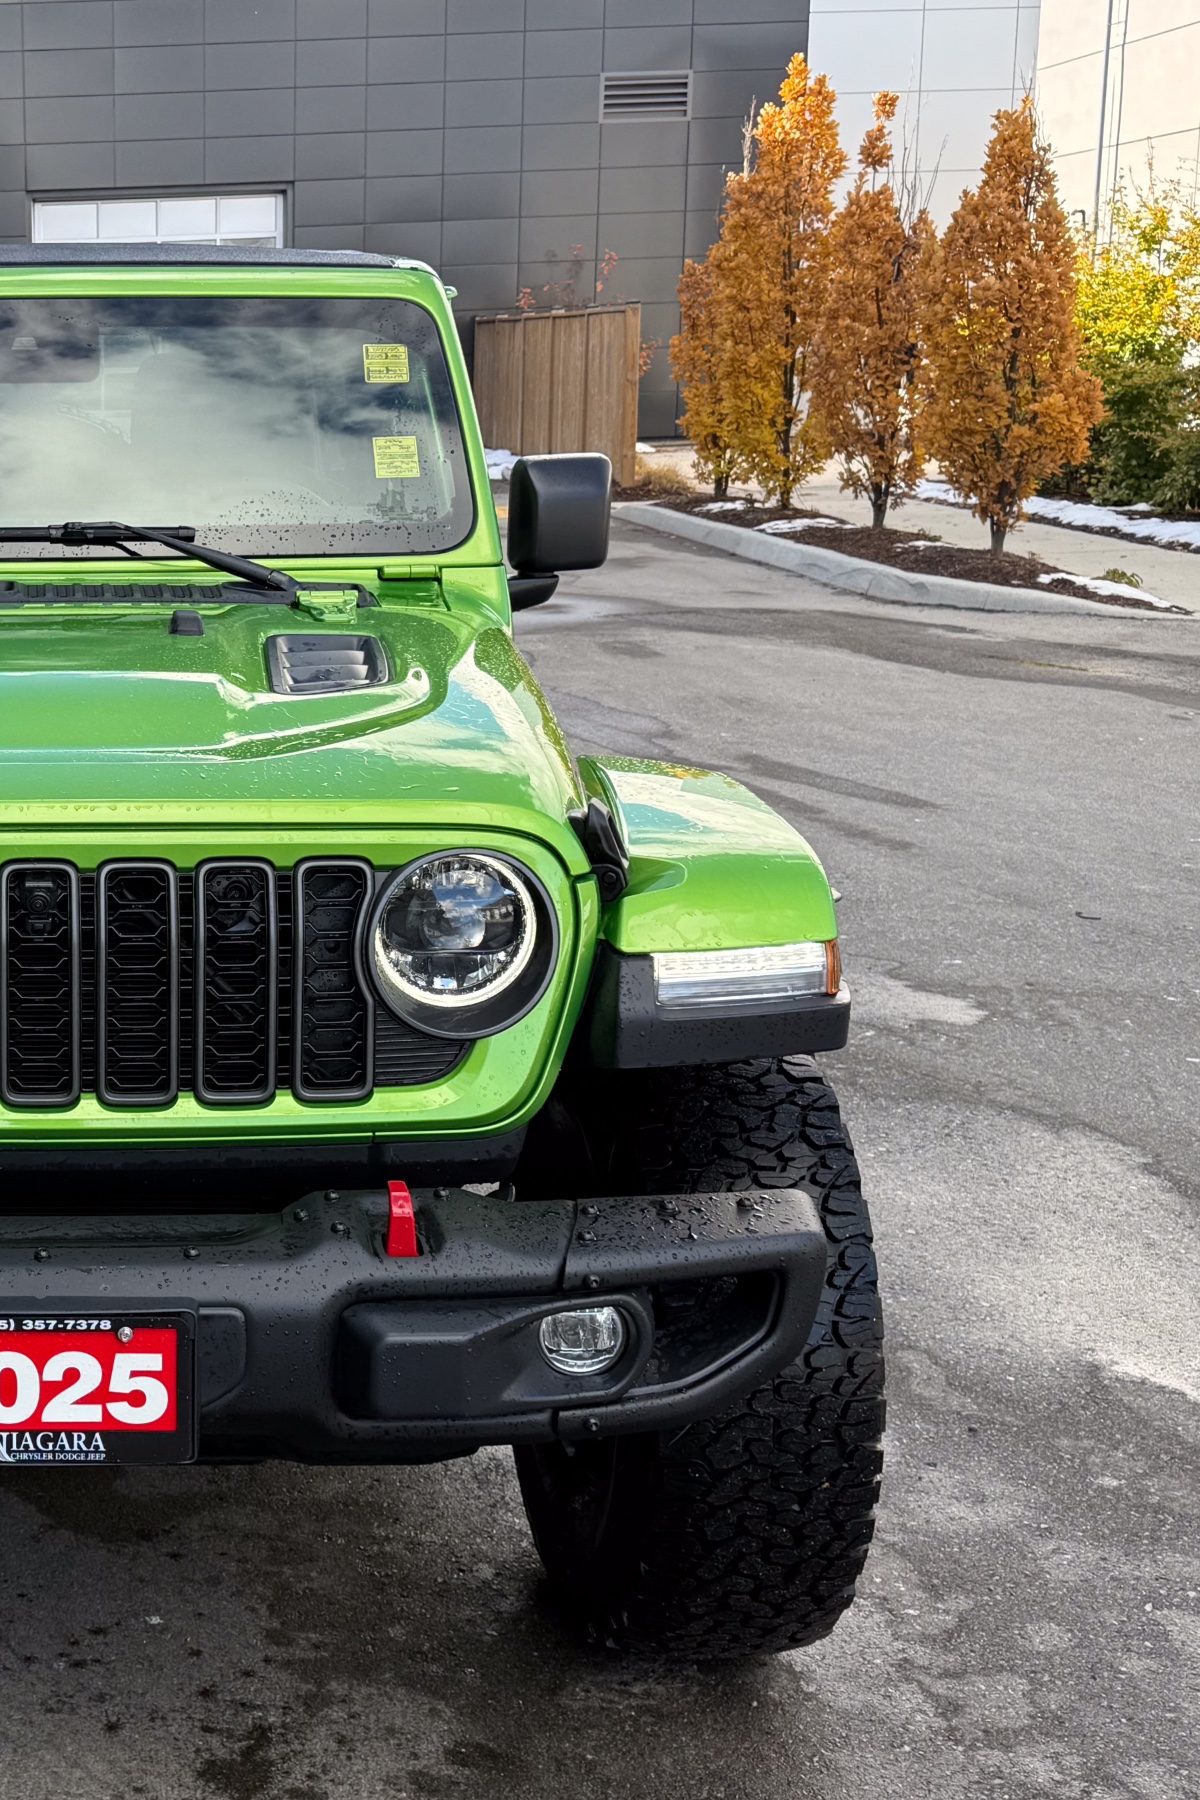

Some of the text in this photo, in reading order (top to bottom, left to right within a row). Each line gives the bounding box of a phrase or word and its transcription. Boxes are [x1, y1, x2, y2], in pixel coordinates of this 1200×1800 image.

[22, 1319, 112, 1330] 357-7378
[10, 1452, 106, 1461] CHRYSLER DODGE JEEP
